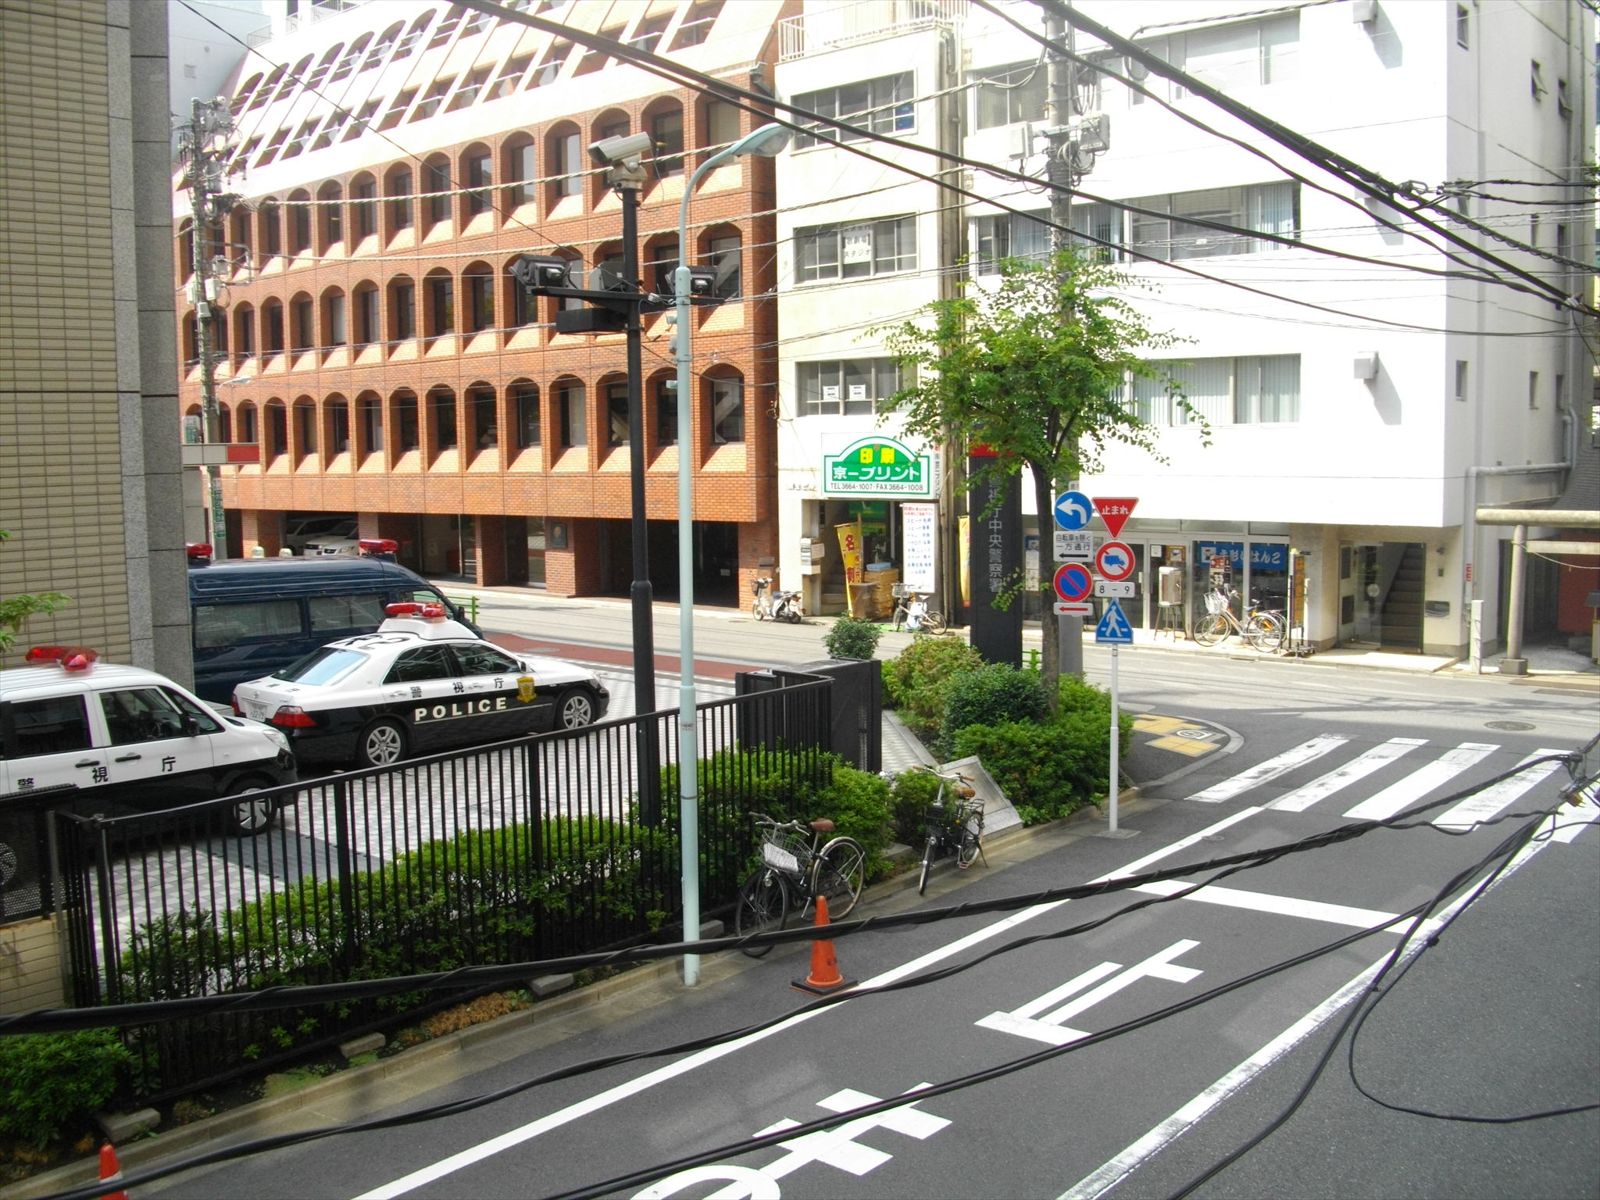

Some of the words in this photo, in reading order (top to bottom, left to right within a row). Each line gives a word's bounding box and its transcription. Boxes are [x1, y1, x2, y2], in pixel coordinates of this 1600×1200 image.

[1101, 505, 1130, 515] 止まれ
[1056, 542, 1091, 551] 一方通行
[410, 677, 505, 699] 警視庁
[414, 697, 508, 722] POLICE
